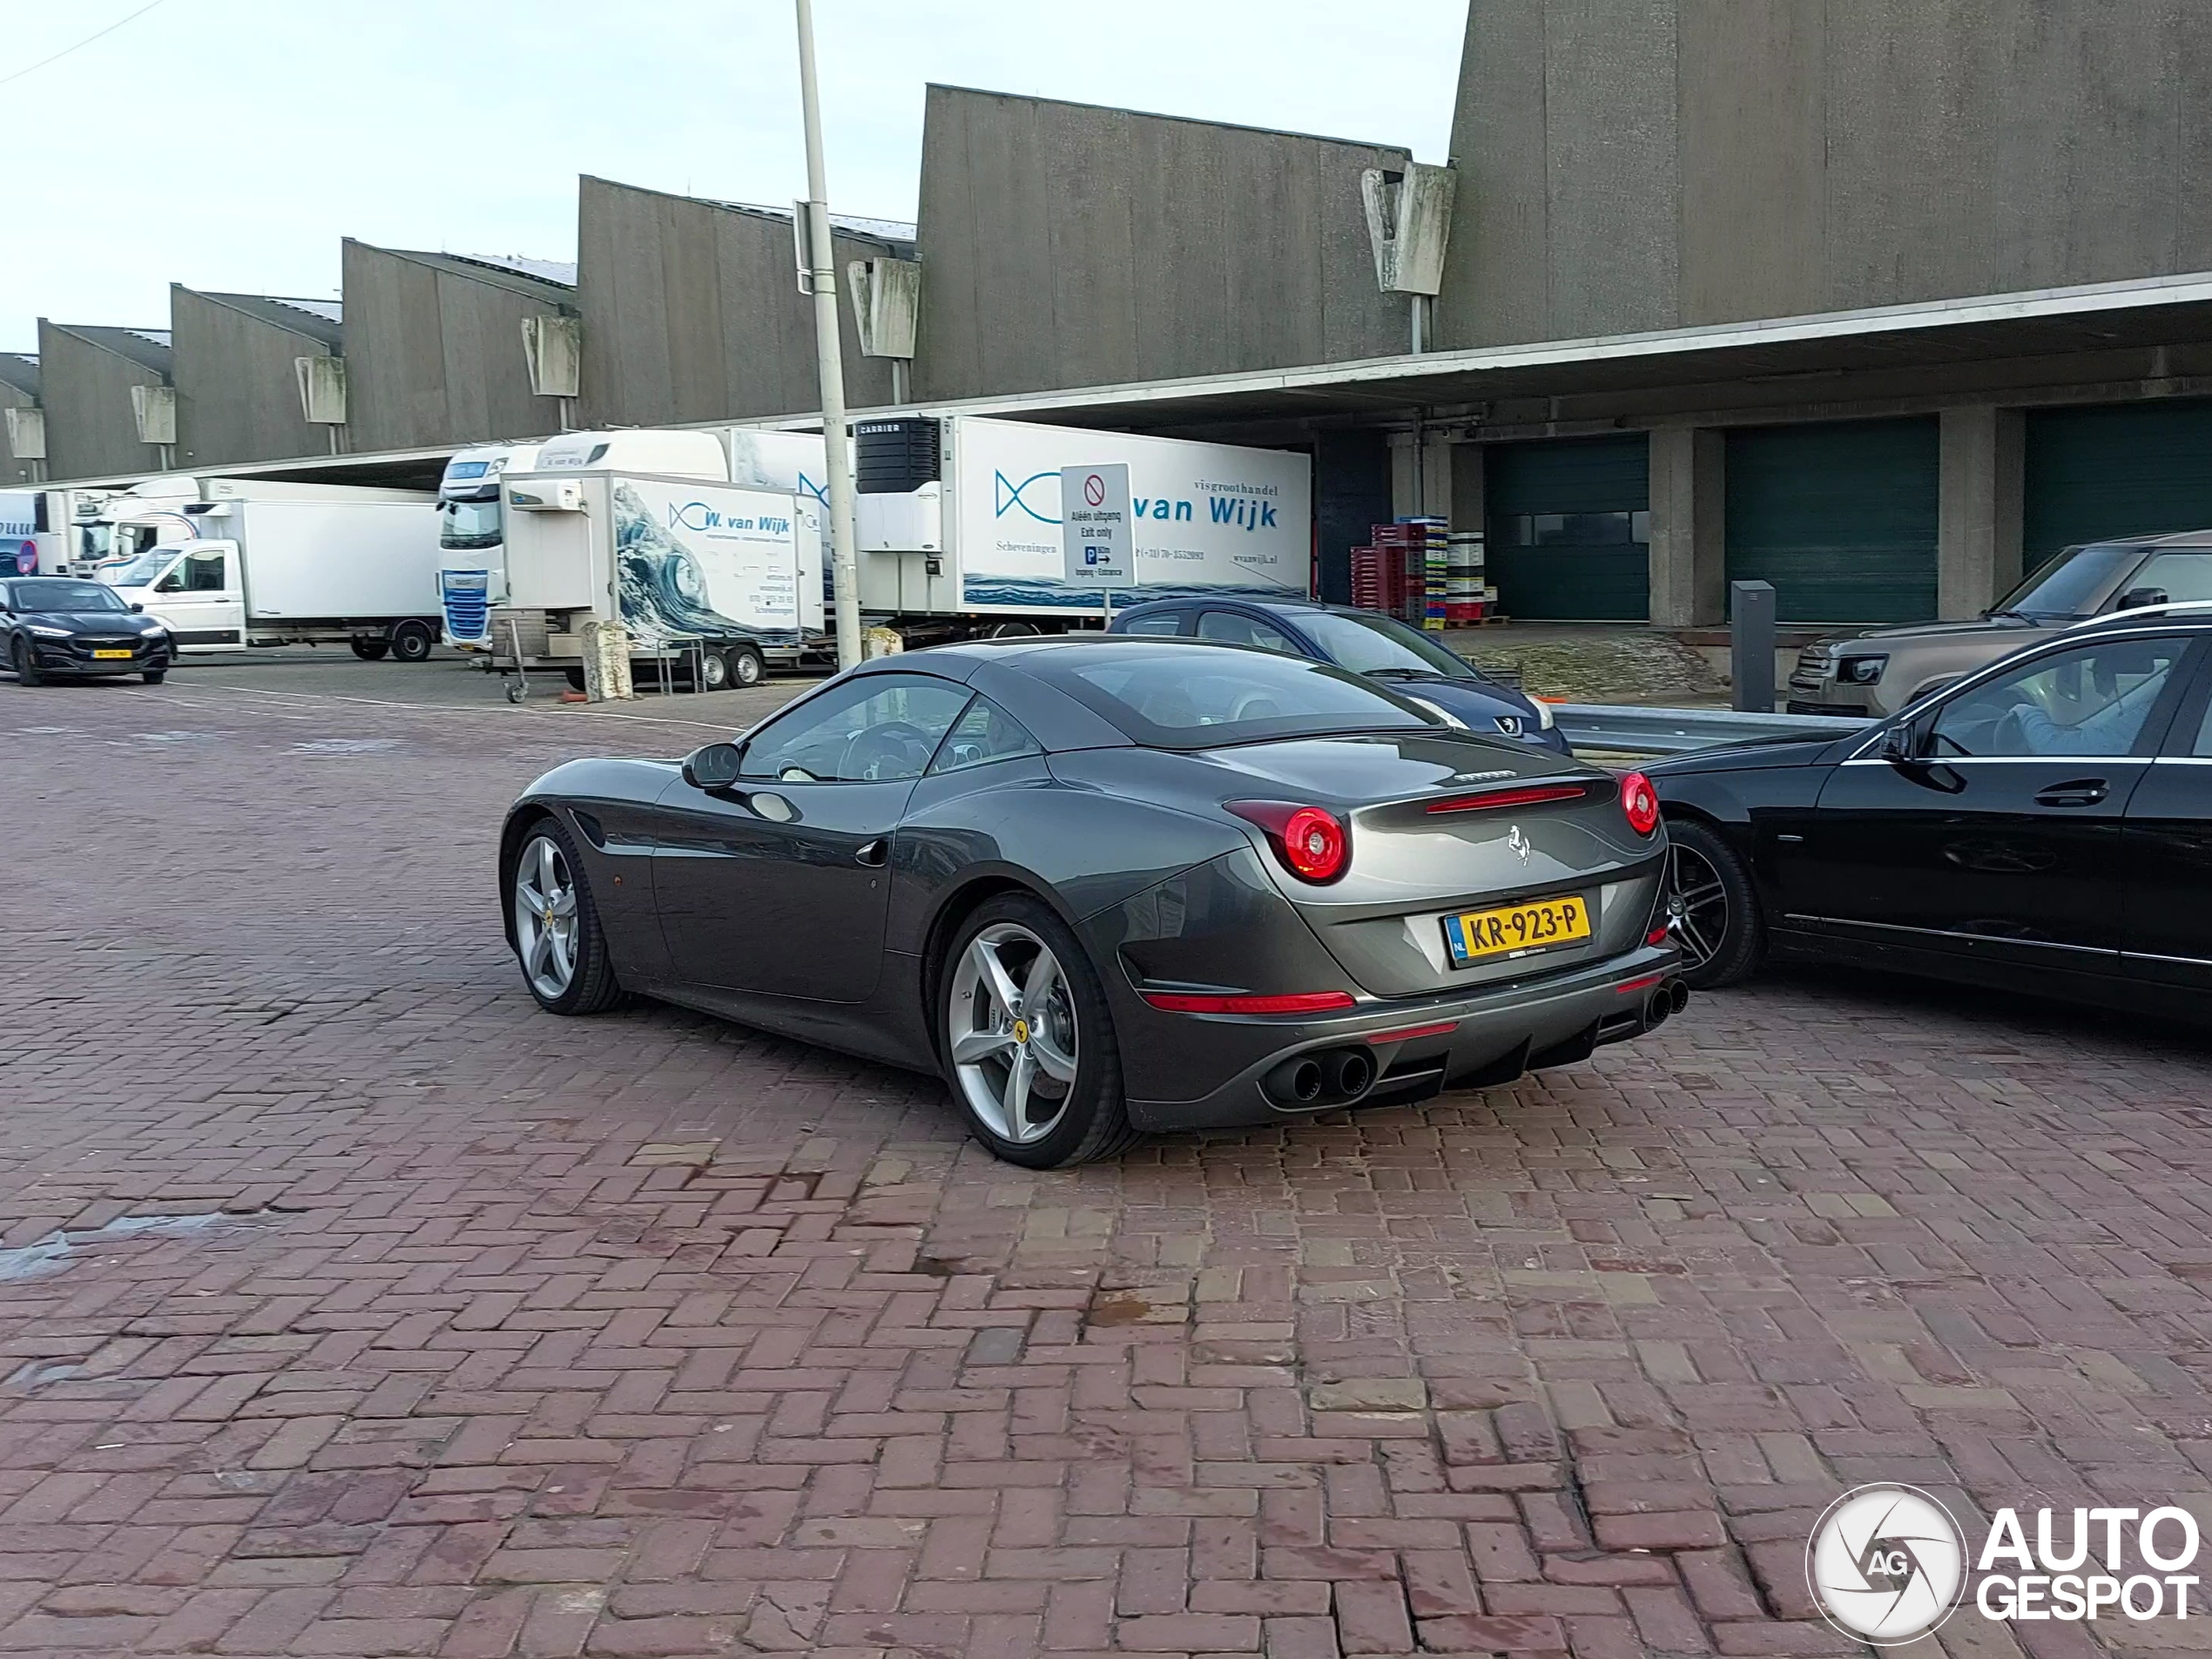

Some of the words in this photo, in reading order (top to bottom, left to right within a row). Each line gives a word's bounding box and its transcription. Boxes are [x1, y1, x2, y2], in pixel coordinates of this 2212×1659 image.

[860, 424, 900, 434] CARRIER
[1194, 480, 1278, 496] visgroothandel
[1133, 497, 1192, 522] van
[1210, 496, 1278, 531] Wijk
[705, 511, 722, 528] W.
[727, 516, 753, 529] van
[759, 516, 791, 535] Wijk
[1081, 527, 1096, 537] Exit
[1096, 527, 1113, 540] only
[995, 540, 1057, 555] Scheveningen
[1098, 568, 1123, 577] Entrance
[1453, 942, 1466, 952] NL
[1469, 904, 1577, 950] KR-923-P
